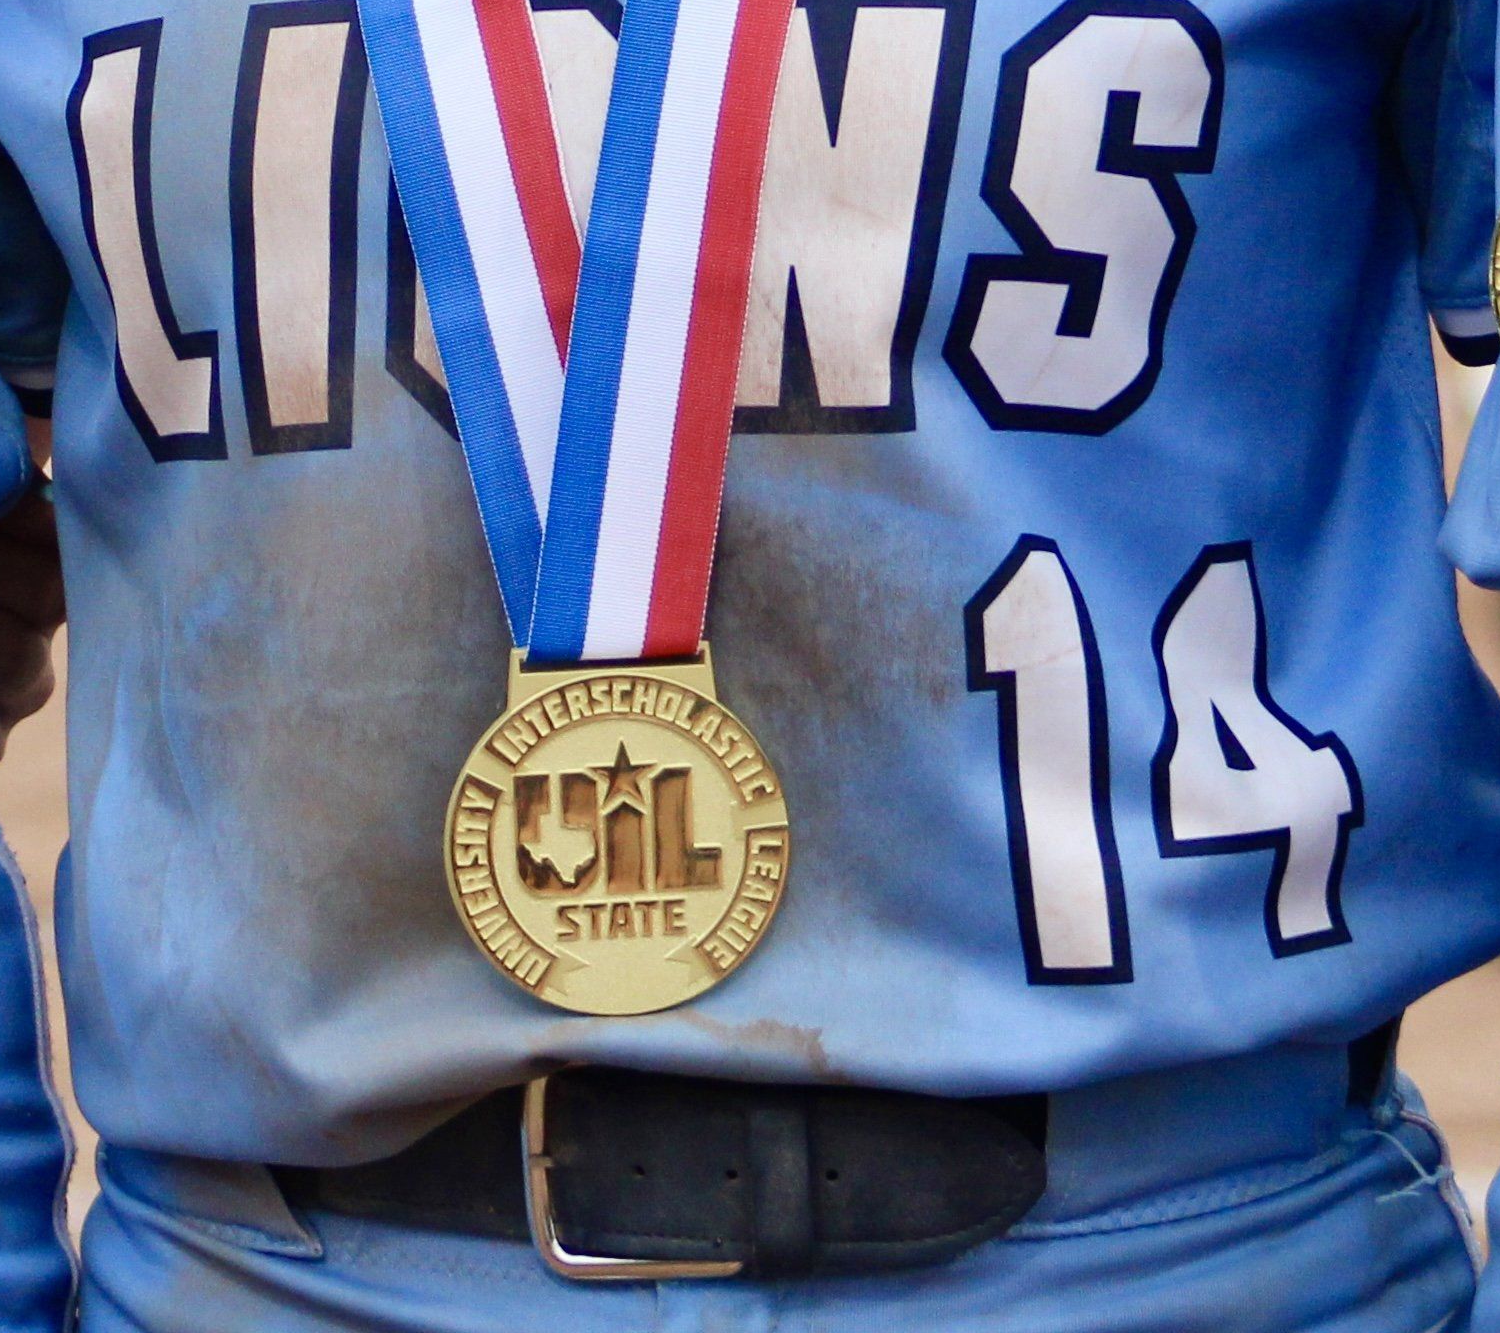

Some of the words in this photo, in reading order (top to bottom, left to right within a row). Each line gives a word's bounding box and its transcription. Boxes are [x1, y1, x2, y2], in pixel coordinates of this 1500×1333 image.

[489, 681, 774, 802] INTERSCHOLASTIC
[965, 533, 1364, 985] 14
[455, 782, 551, 986] UNIVERSITY
[556, 900, 687, 941] STATE
[705, 836, 783, 970] LEAGUE
